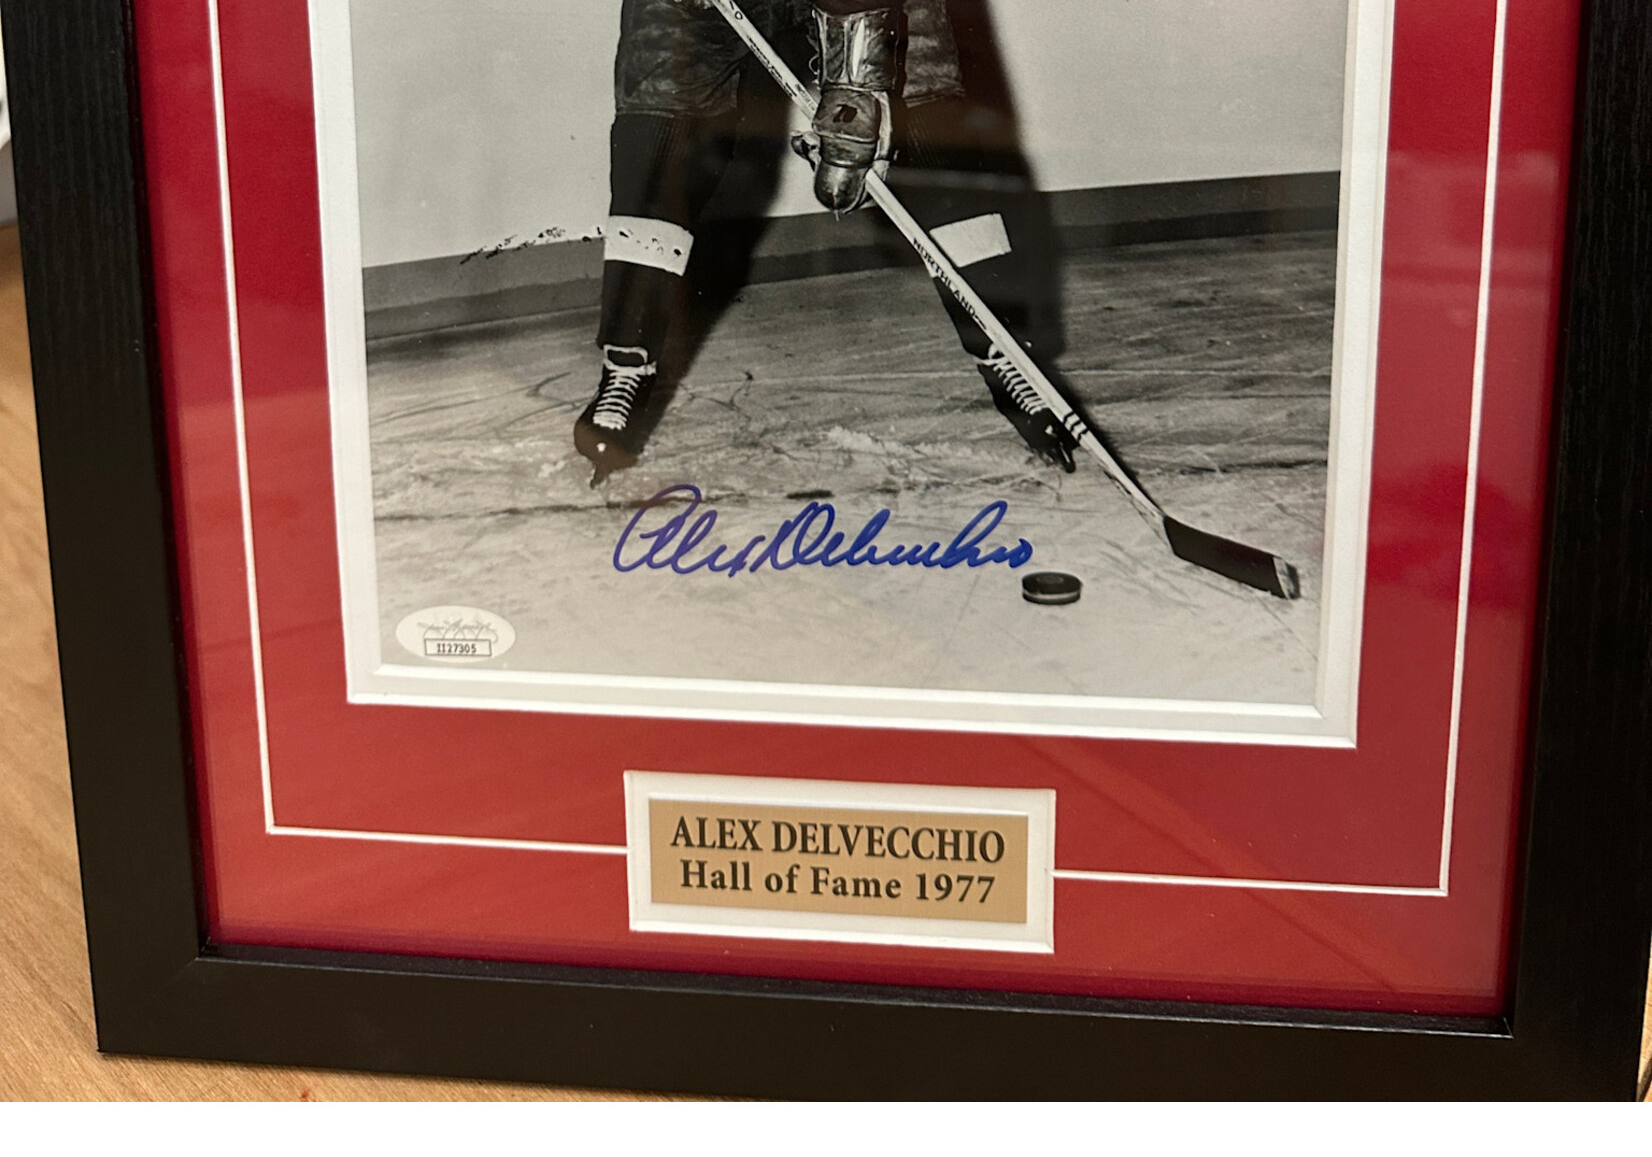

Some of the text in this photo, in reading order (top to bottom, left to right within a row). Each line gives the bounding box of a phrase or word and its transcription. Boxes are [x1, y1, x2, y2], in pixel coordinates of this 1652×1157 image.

[670, 815, 1006, 864] ALEX DELVECCHIO
[680, 858, 996, 904] Hall of Fame 1977
